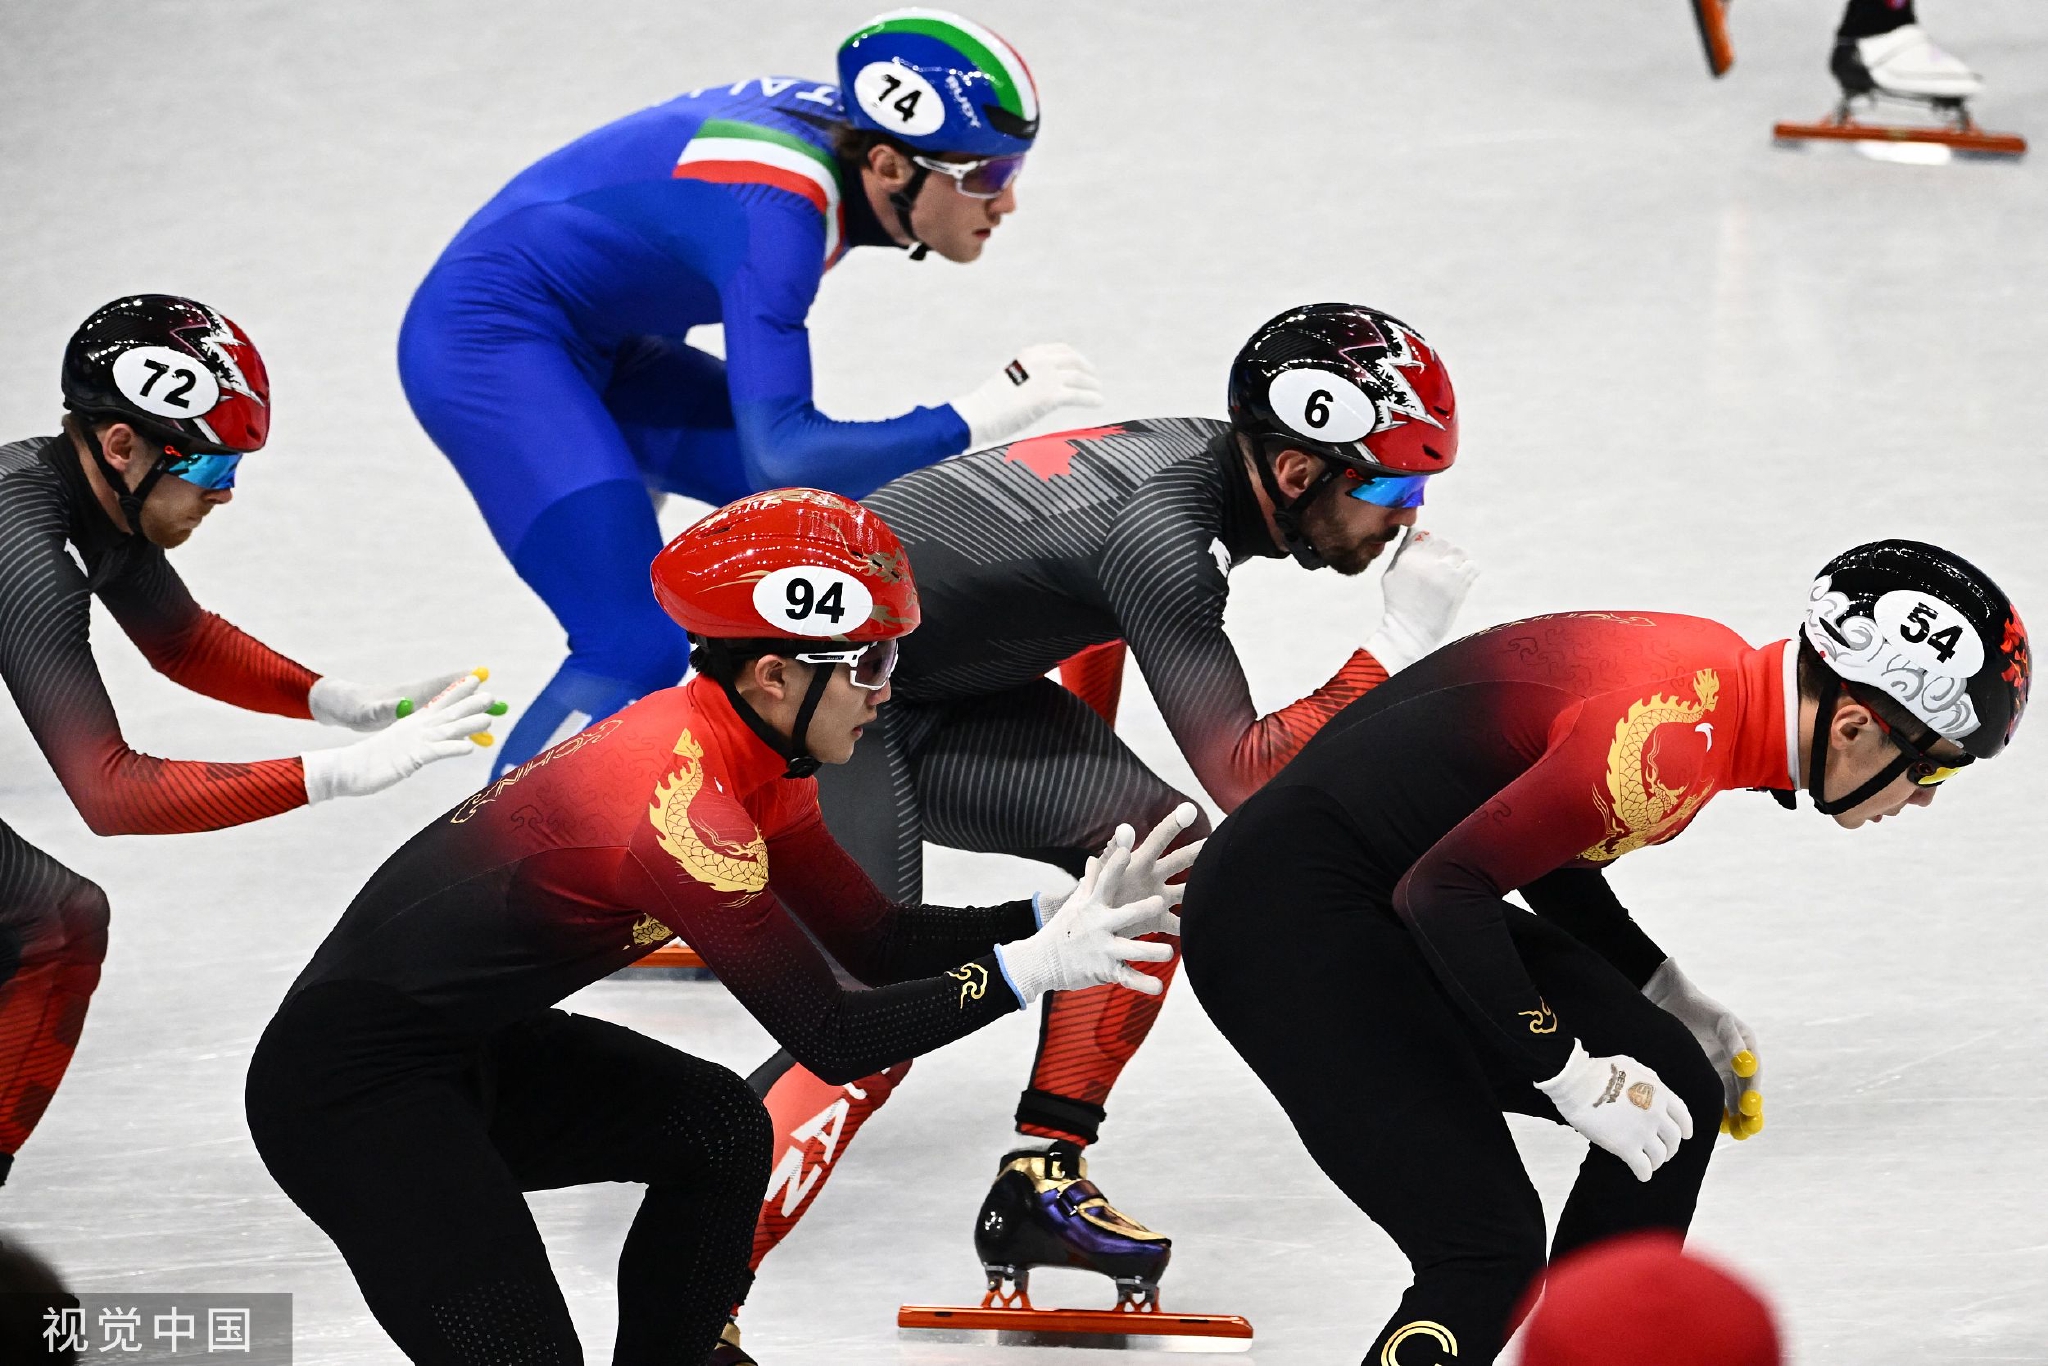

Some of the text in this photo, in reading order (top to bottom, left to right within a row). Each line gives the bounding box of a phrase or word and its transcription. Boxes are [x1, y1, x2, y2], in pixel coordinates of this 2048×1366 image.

[878, 73, 922, 123] 74
[140, 358, 197, 409] 72
[1304, 389, 1334, 429] 6
[785, 578, 845, 623] 94
[1900, 602, 1964, 664] 54
